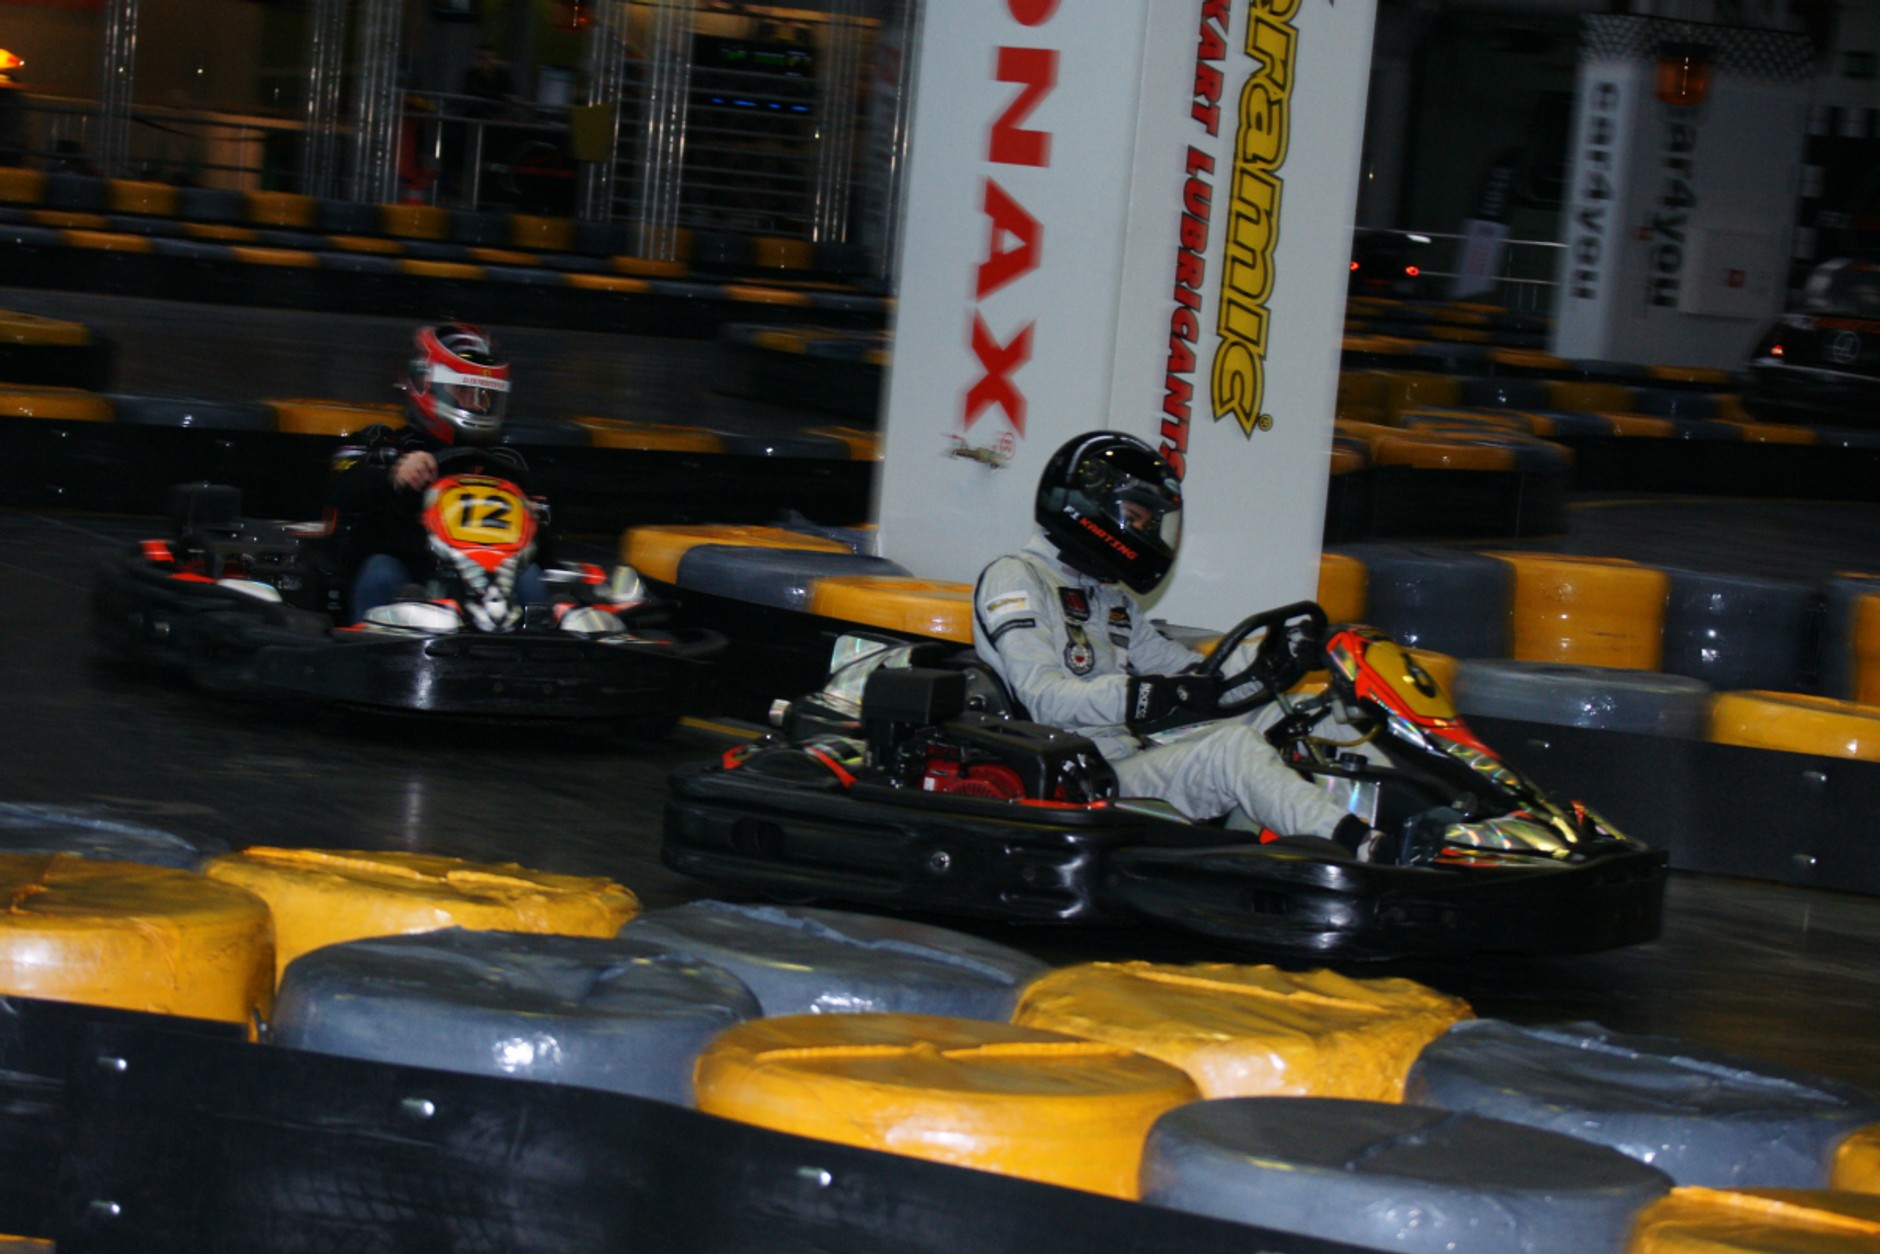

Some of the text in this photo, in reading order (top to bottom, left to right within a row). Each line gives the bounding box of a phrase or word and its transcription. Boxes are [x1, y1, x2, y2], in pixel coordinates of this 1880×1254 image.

[1191, 0, 1230, 138] KART
[958, 0, 1061, 440] NAX
[1211, 0, 1299, 440] ramic
[460, 493, 512, 529] 12
[1079, 516, 1140, 561] KARTING
